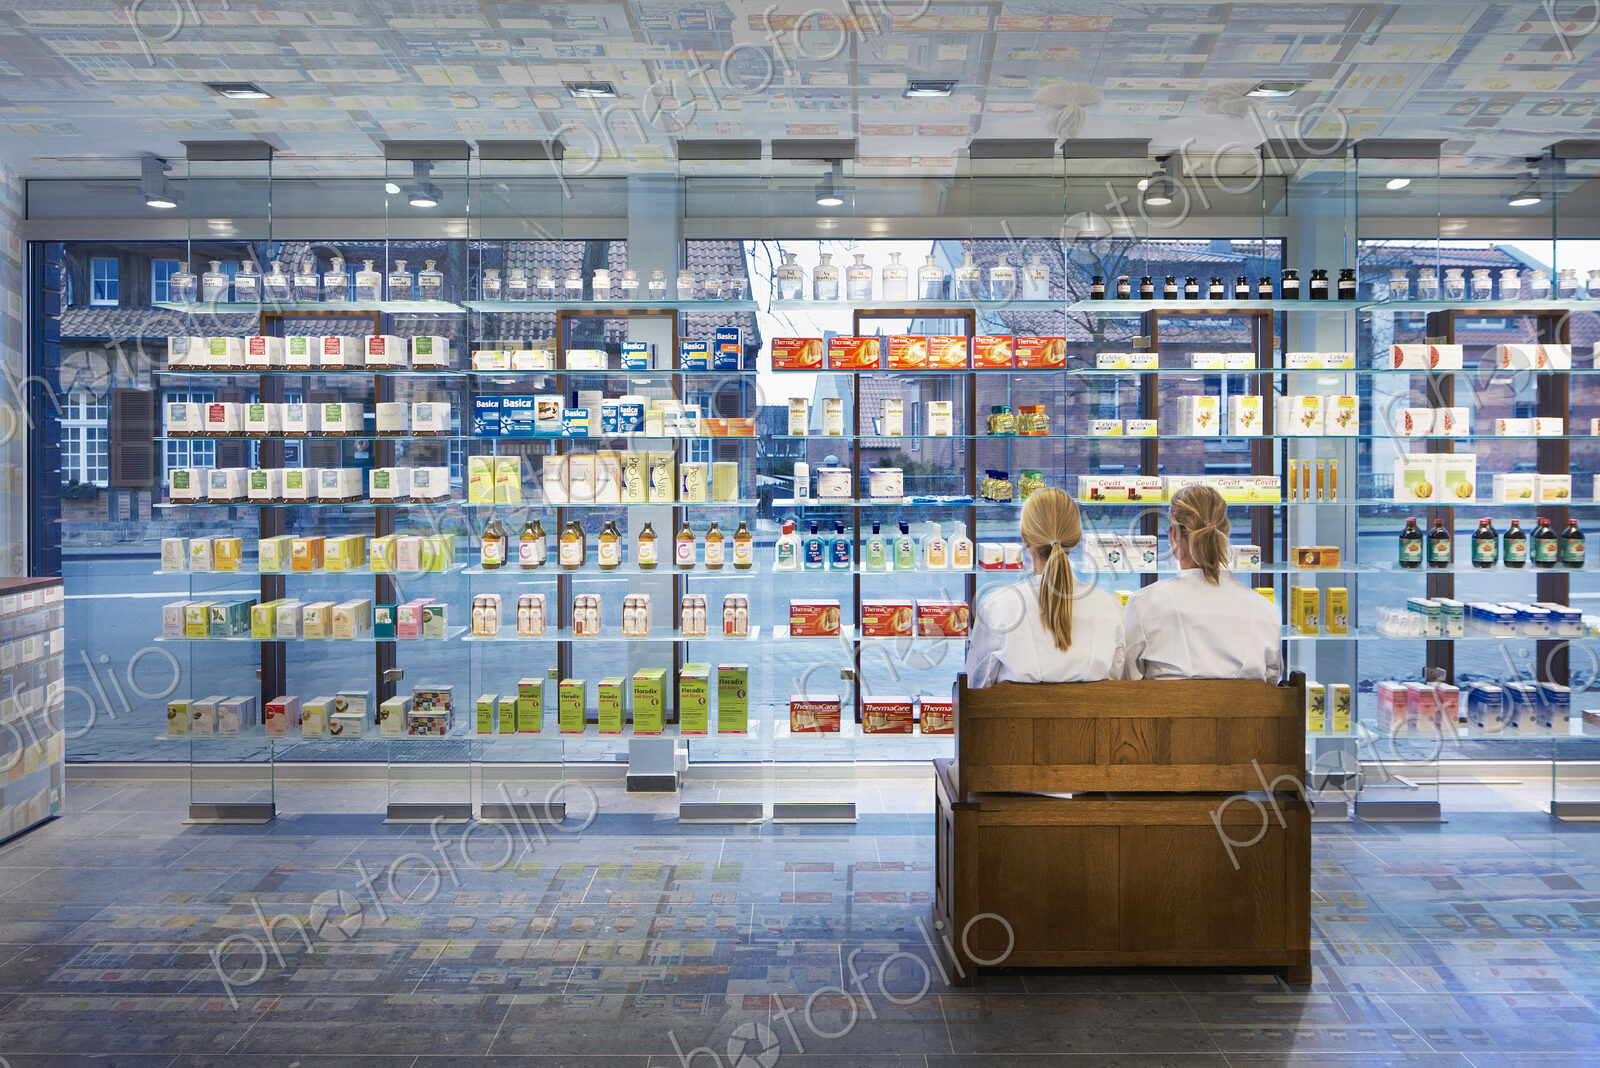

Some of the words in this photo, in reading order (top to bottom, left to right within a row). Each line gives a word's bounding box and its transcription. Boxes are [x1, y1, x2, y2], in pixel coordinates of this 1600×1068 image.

[716, 332, 737, 340] Basica
[623, 342, 645, 350] Basica
[683, 342, 705, 350] Basica
[476, 400, 499, 408] Basica
[503, 398, 532, 408] Basica
[564, 409, 587, 417] Basica
[1098, 479, 1121, 487] Cevitt
[1135, 479, 1159, 487] Cevitt
[1180, 479, 1204, 487] Cevitt
[1217, 479, 1241, 487] Cevitt
[1254, 479, 1278, 487] Cevitt
[791, 606, 823, 614] ThermaCare
[863, 606, 895, 614] ThermaCare
[920, 606, 950, 614] ThermaCare
[793, 703, 838, 711] ThermaCare
[865, 704, 911, 712] ThermaCare
